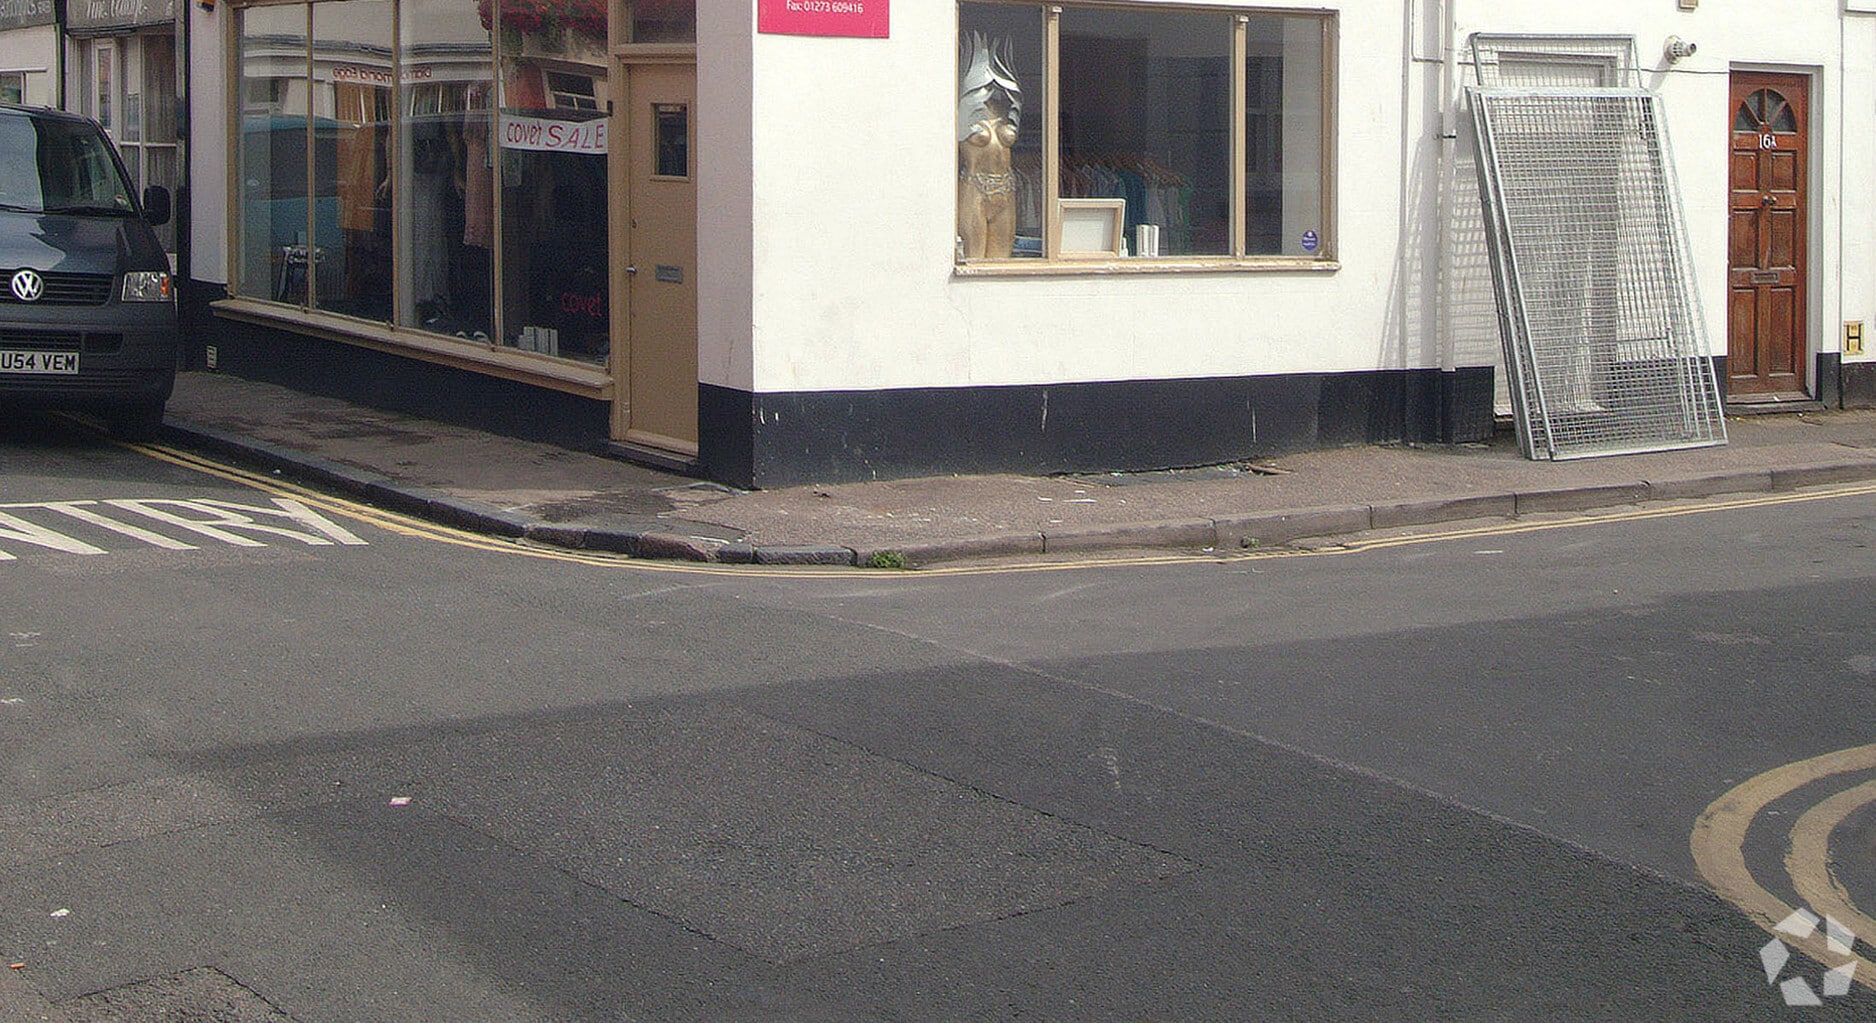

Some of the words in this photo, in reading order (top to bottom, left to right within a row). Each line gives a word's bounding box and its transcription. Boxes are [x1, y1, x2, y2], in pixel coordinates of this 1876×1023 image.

[803, 0, 830, 12] 01273
[832, 1, 864, 13] 609416
[506, 120, 542, 146] covet
[545, 124, 604, 149] SALE
[1758, 133, 1777, 149] 16A
[561, 291, 602, 318] covet
[1847, 323, 1863, 351] H
[1, 353, 36, 370] U54
[42, 354, 76, 371] VEM
